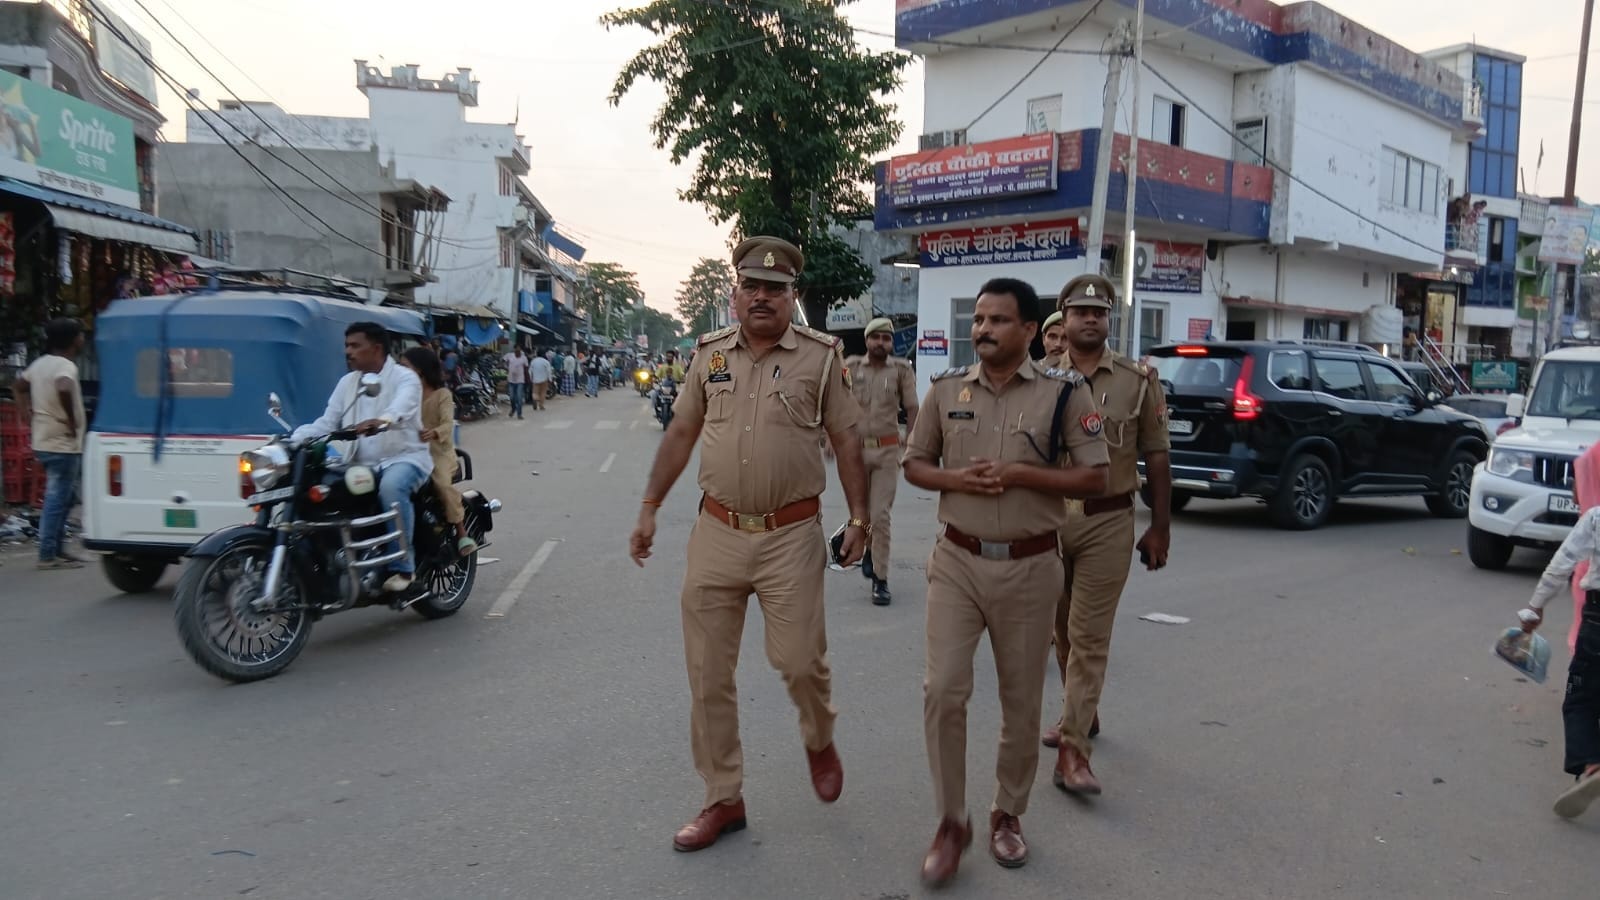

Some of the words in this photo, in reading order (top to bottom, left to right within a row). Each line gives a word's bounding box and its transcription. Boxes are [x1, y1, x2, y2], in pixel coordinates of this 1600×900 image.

[58, 108, 116, 154] Sprite
[894, 161, 943, 183] पुलिस
[946, 152, 993, 171] चौकी
[995, 146, 1050, 164] बदला
[926, 233, 970, 261] पुलिस
